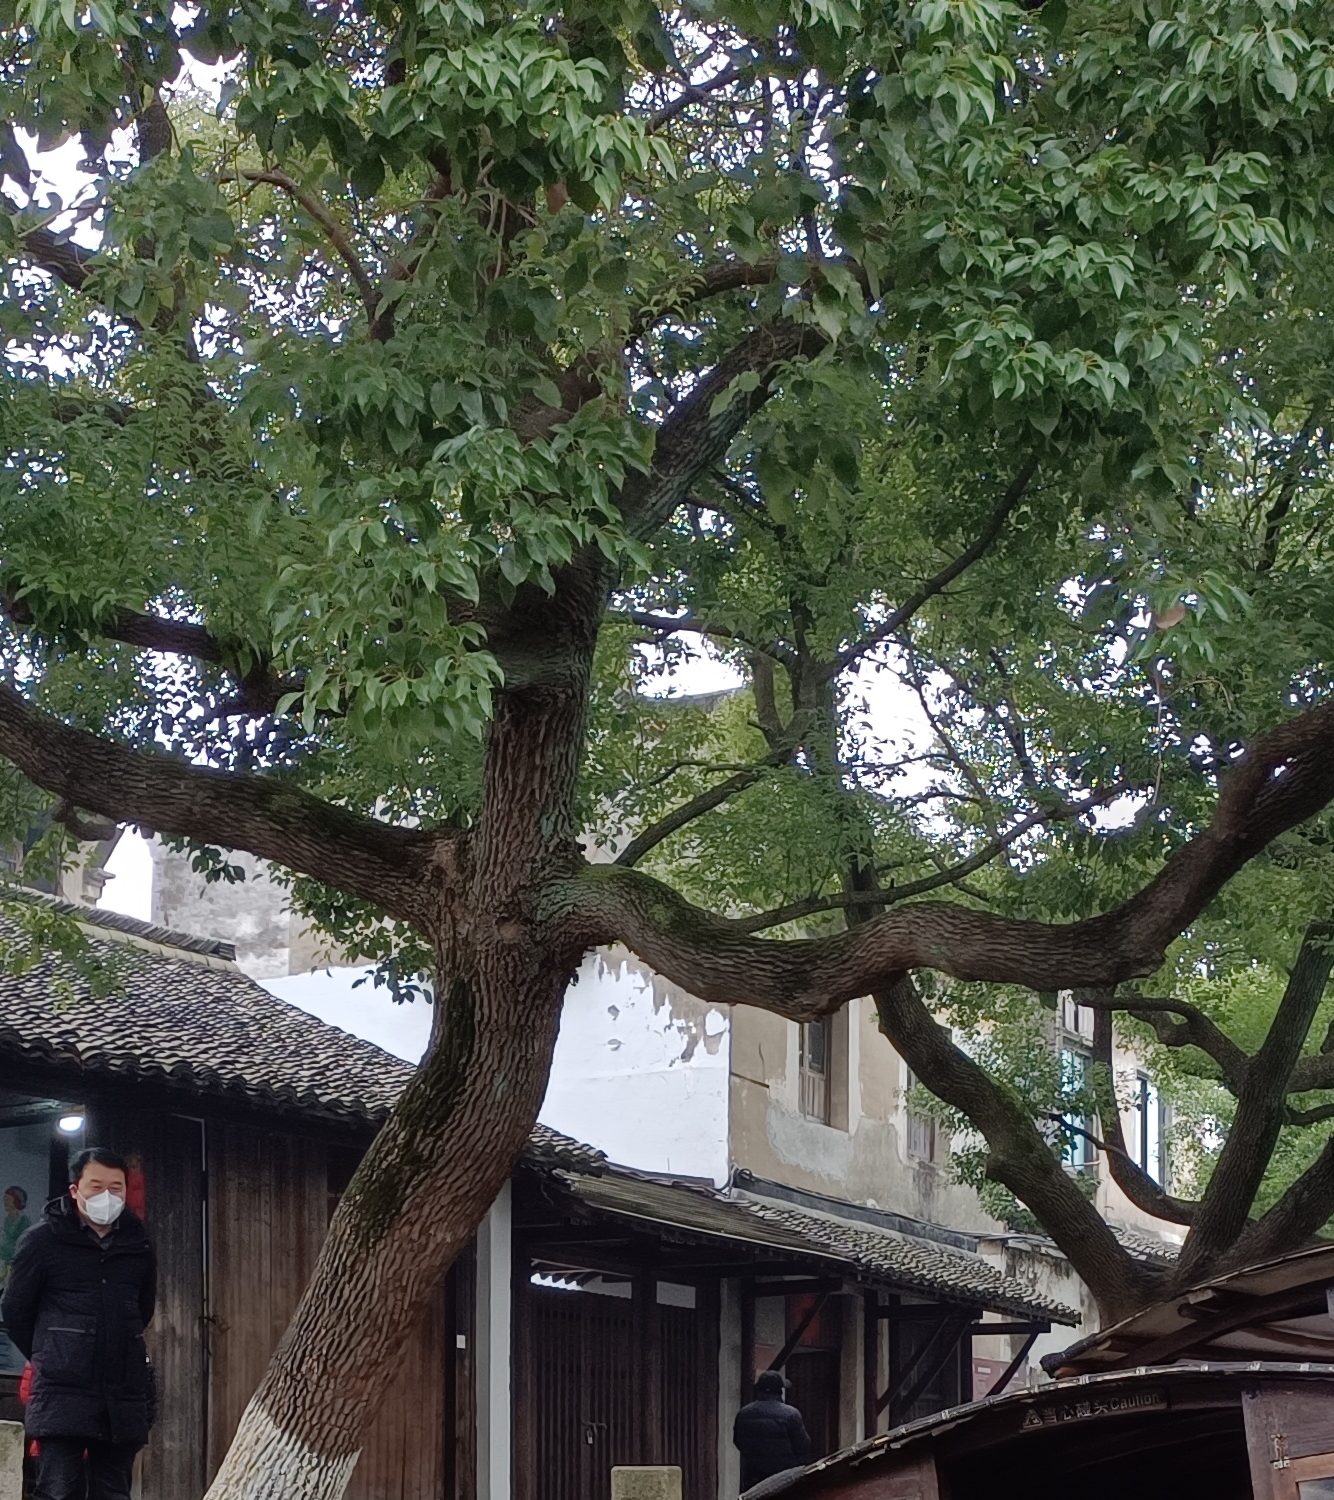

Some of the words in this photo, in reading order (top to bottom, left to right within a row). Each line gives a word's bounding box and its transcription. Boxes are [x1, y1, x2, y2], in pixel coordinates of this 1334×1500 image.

[1043, 1401, 1108, 1424] 当心碰头
[1109, 1393, 1160, 1410] Caution
